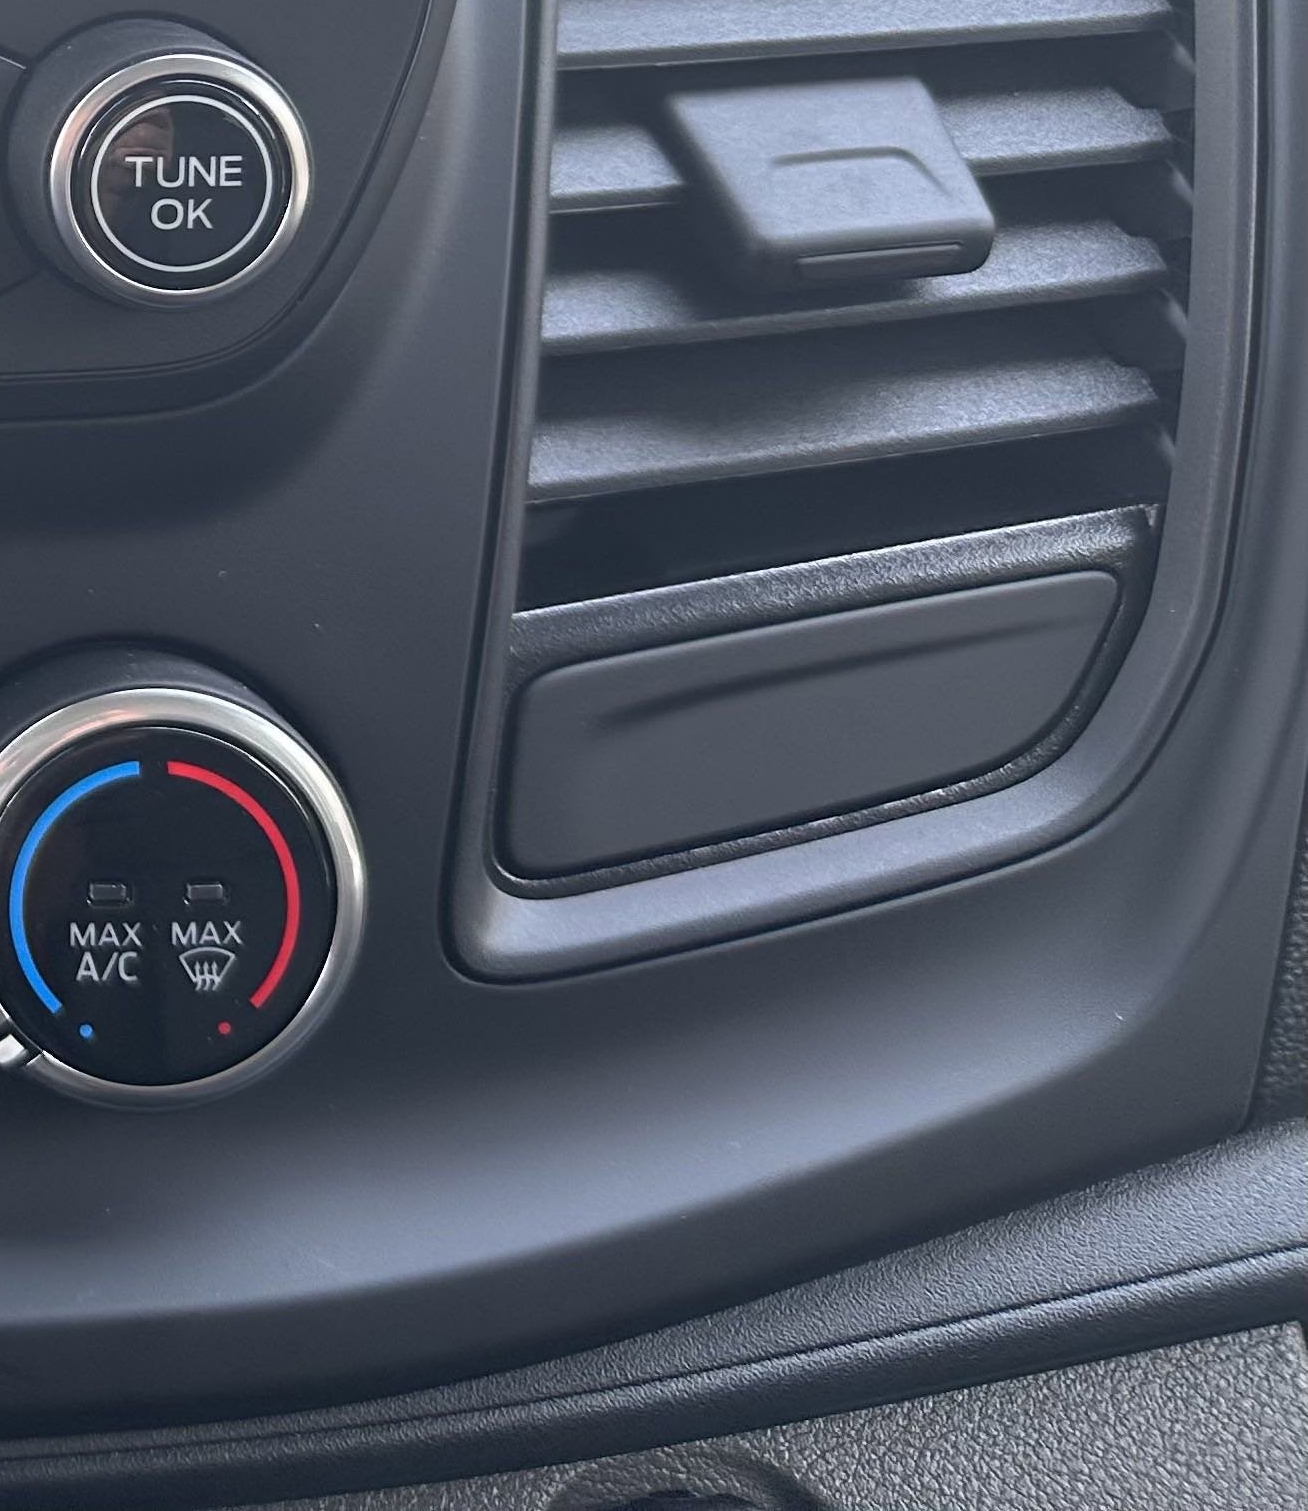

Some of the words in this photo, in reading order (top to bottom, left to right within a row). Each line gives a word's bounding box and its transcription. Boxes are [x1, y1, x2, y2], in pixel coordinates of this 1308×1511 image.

[124, 155, 244, 188] TUNE
[150, 197, 214, 231] OK
[70, 922, 143, 948] MAX
[171, 920, 244, 946] MAX
[75, 951, 140, 982] A/C
